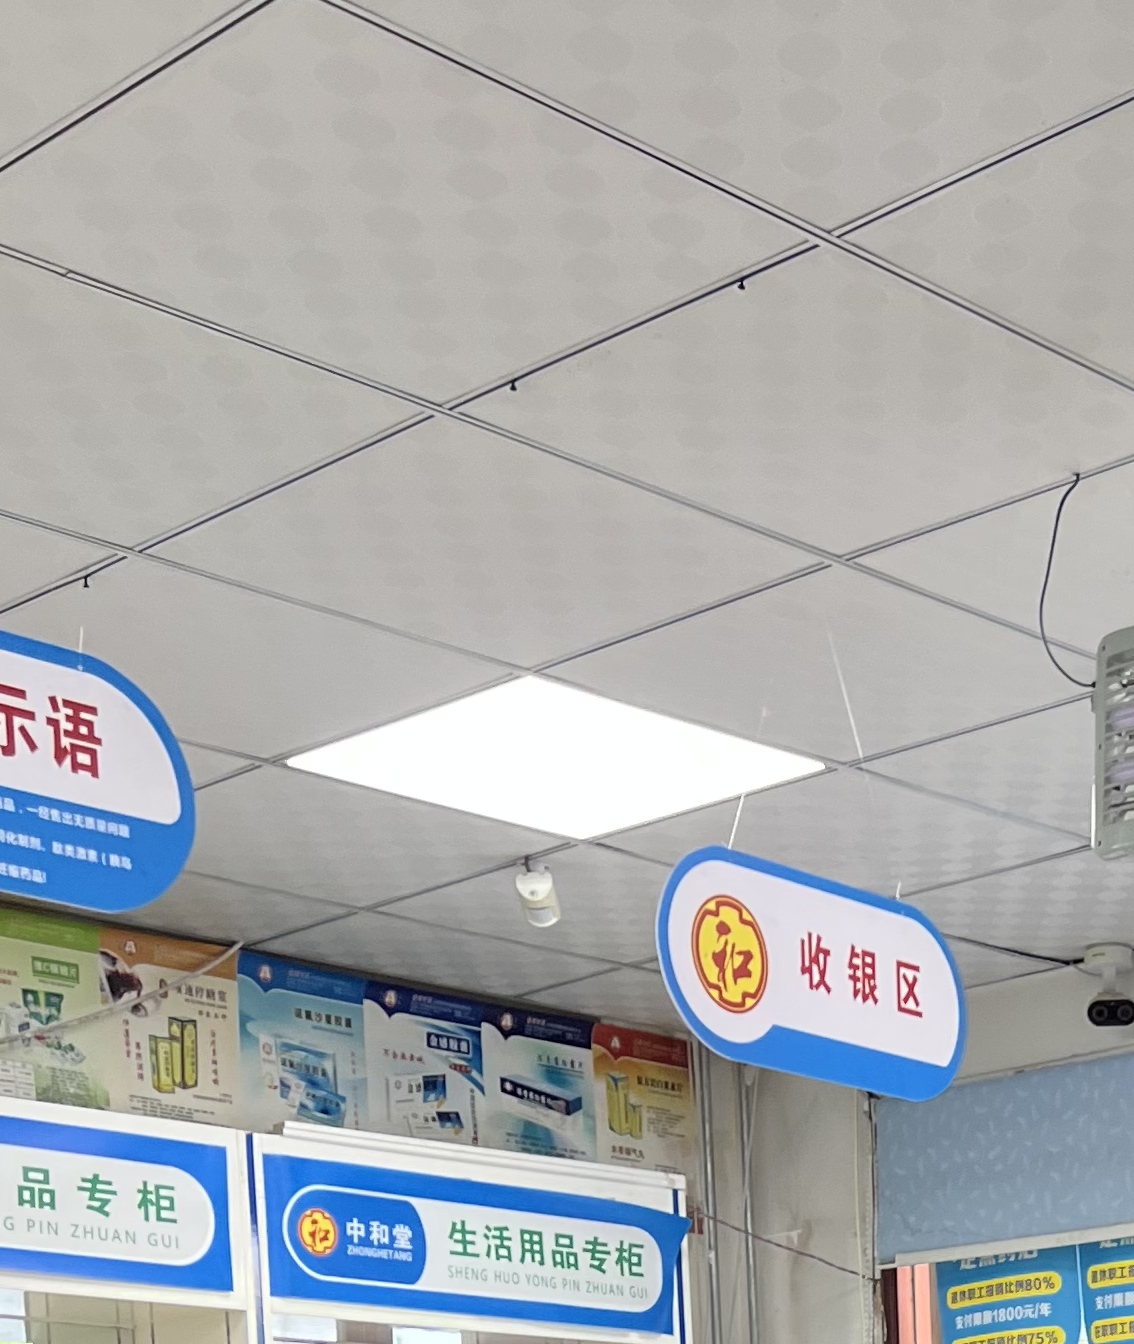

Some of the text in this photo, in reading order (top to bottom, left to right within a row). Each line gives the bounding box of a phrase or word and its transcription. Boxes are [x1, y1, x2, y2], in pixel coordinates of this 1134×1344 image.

[0, 684, 102, 779] 示语
[800, 931, 923, 1018] 收银区
[17, 1165, 178, 1224] 品专柜
[26, 1218, 59, 1236] PIN
[70, 1223, 136, 1245] ZHUAN
[147, 1232, 180, 1249] GUI
[345, 1216, 413, 1250] 中和堂
[346, 1244, 412, 1262] ZHONGHETANG
[447, 1219, 645, 1279] 生活用品专柜
[447, 1264, 648, 1300] SHENG HUO YONG PIN ZHUAN GUI
